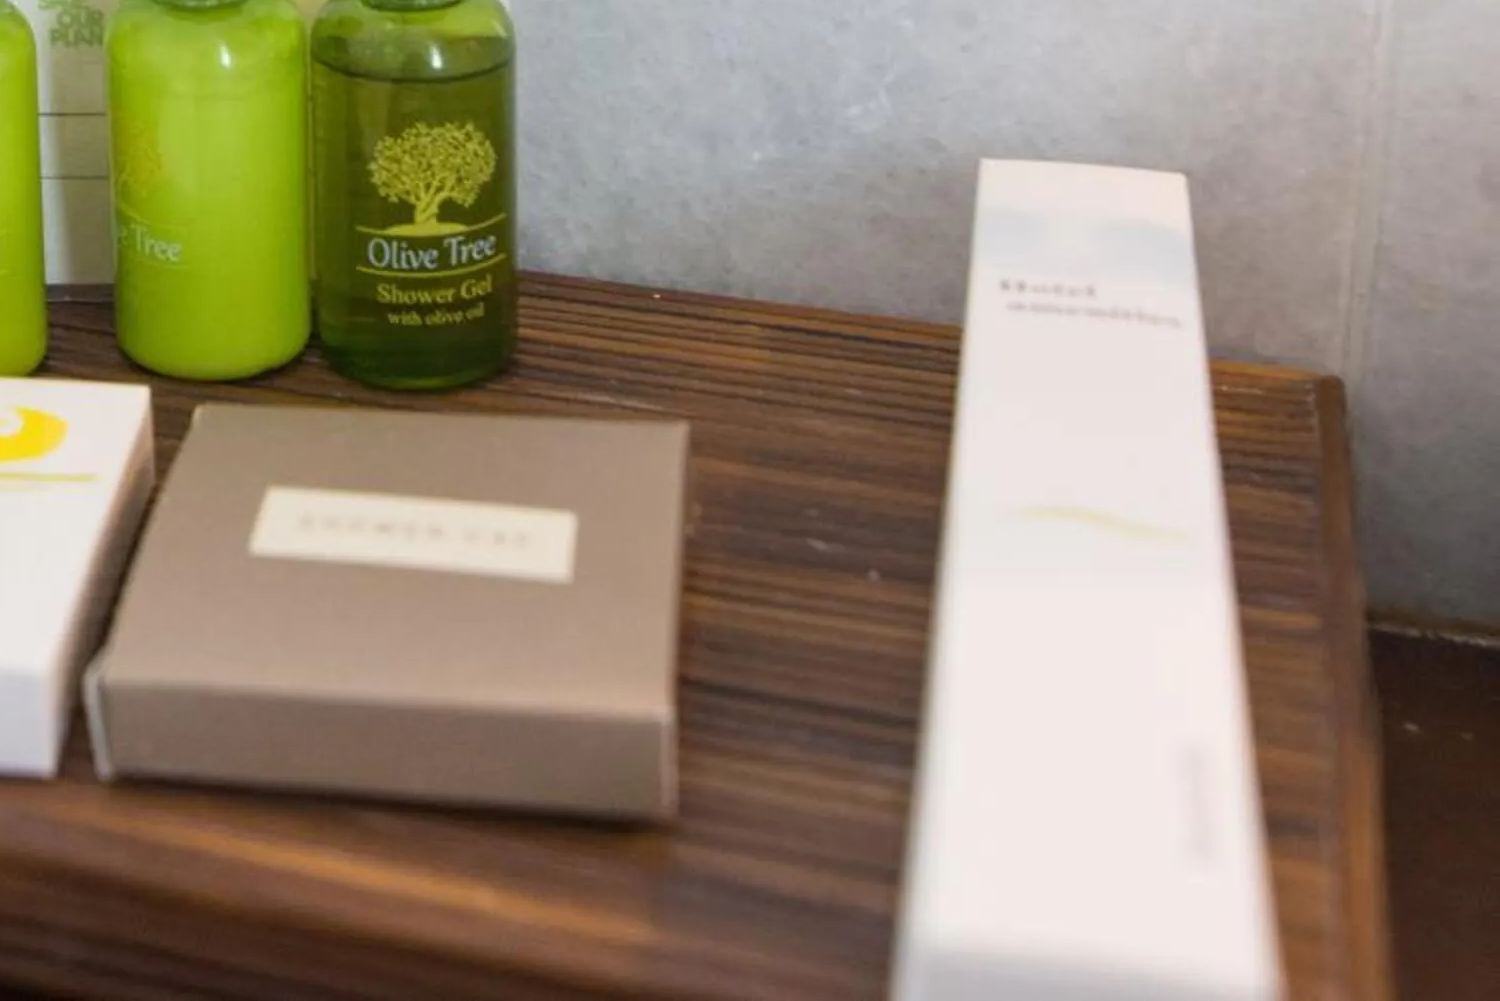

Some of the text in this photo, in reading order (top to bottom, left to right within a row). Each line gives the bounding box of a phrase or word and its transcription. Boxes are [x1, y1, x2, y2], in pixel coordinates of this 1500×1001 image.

[130, 222, 182, 263] Tree
[367, 235, 497, 270] Olive Tree
[377, 273, 492, 304] Shower Gel
